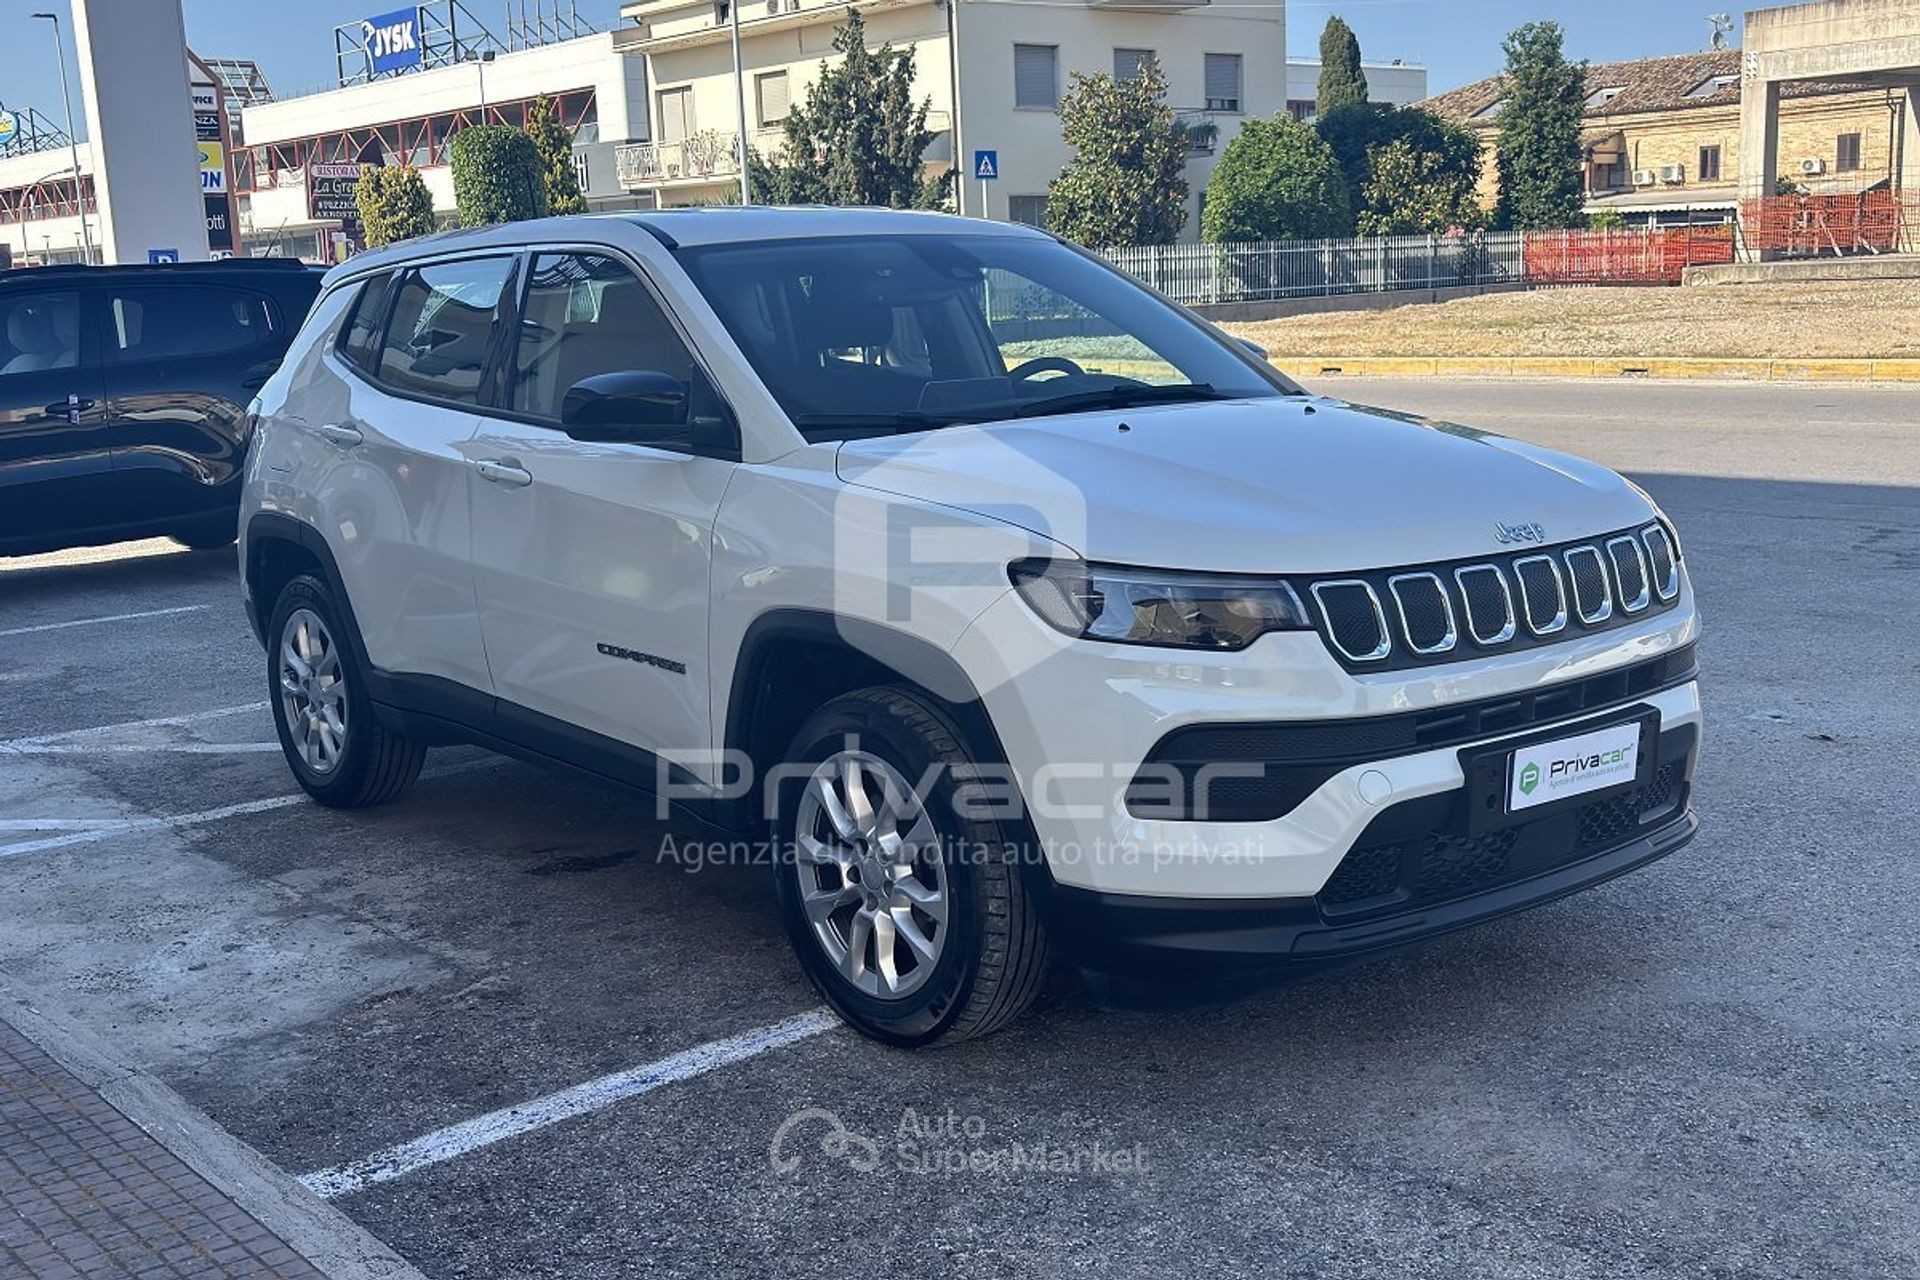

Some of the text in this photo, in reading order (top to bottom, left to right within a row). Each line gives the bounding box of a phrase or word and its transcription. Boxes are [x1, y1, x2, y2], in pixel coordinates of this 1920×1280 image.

[374, 21, 416, 57] JYSK
[314, 178, 330, 193] La
[206, 214, 226, 230] otti
[1494, 522, 1545, 544] Jeep
[597, 642, 686, 675] COMPASS
[1550, 745, 1632, 778] Privacar
